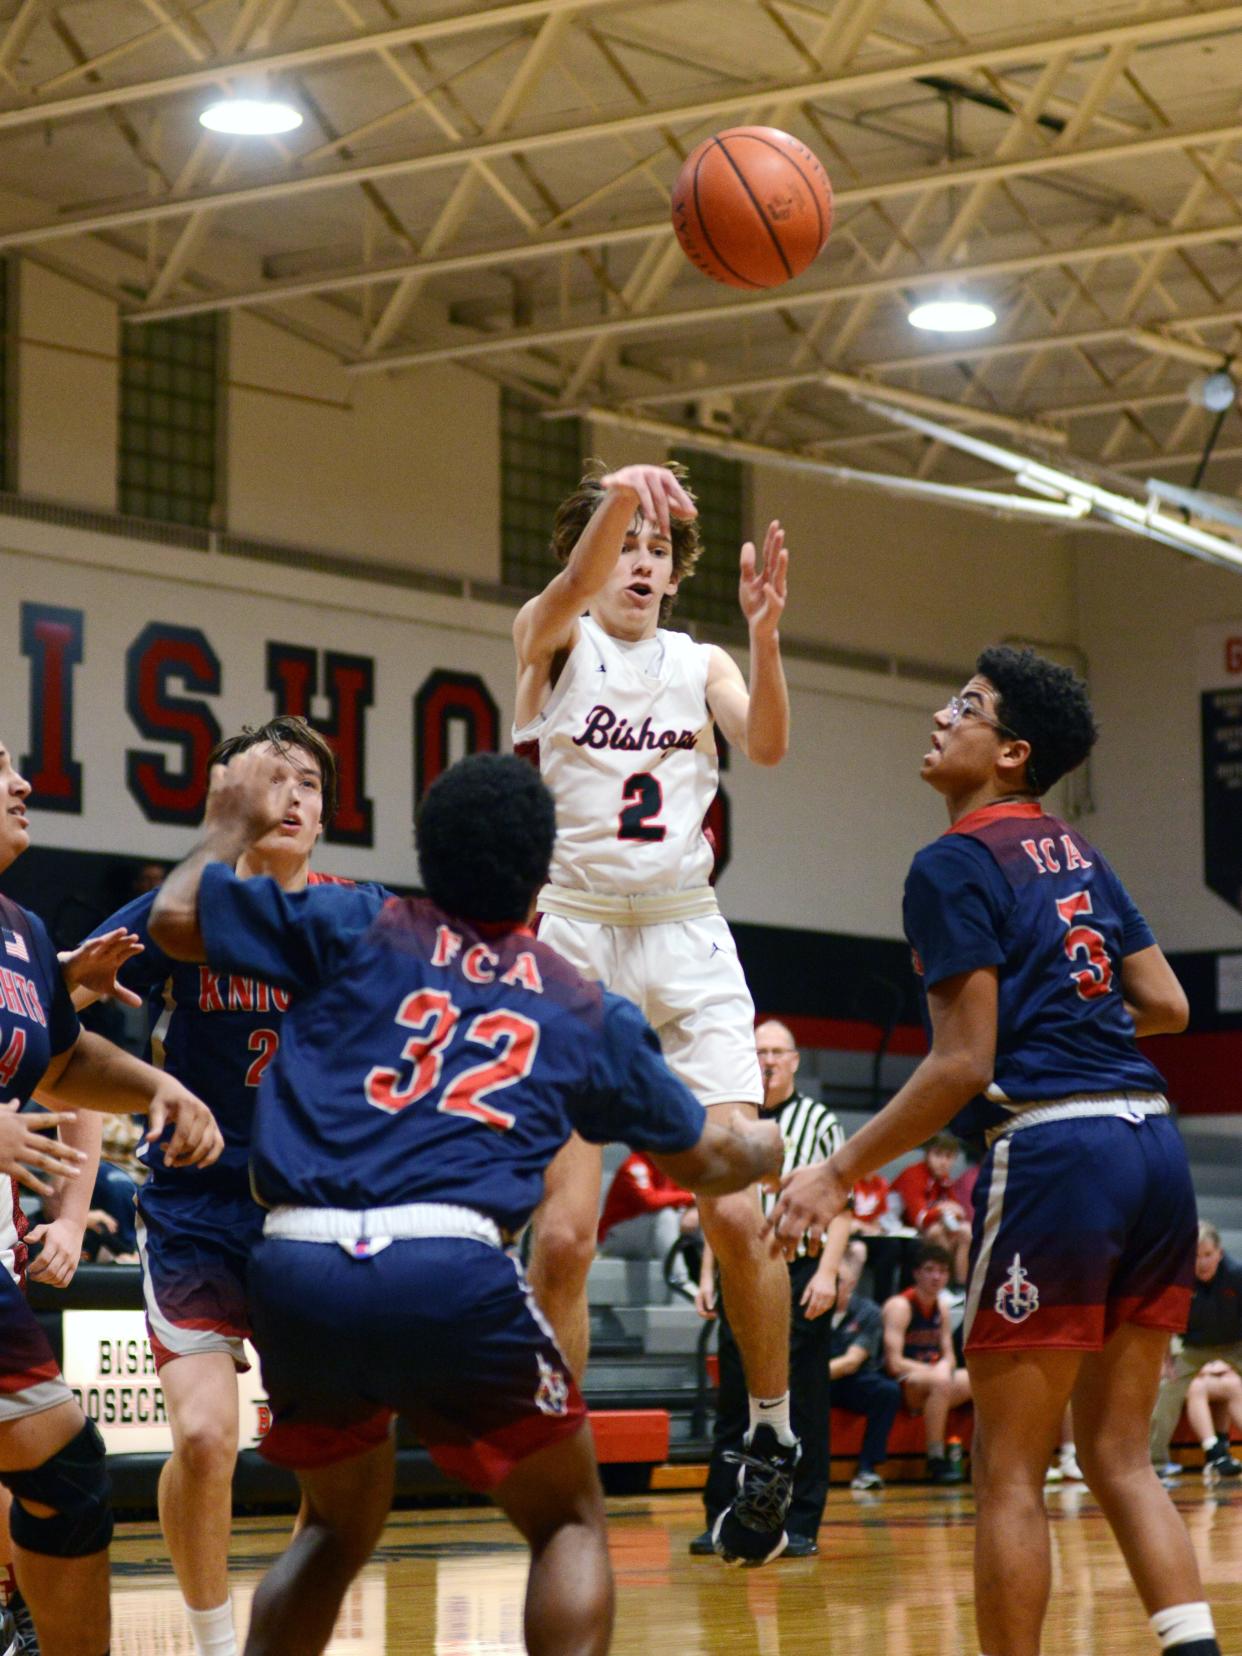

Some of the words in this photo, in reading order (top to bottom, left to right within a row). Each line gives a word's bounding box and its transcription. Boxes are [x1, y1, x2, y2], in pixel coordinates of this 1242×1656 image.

[617, 772, 666, 842] 2
[0, 966, 47, 1028] HTS
[0, 1027, 26, 1088] 4
[364, 987, 541, 1129] 32
[98, 1340, 154, 1375] BISH
